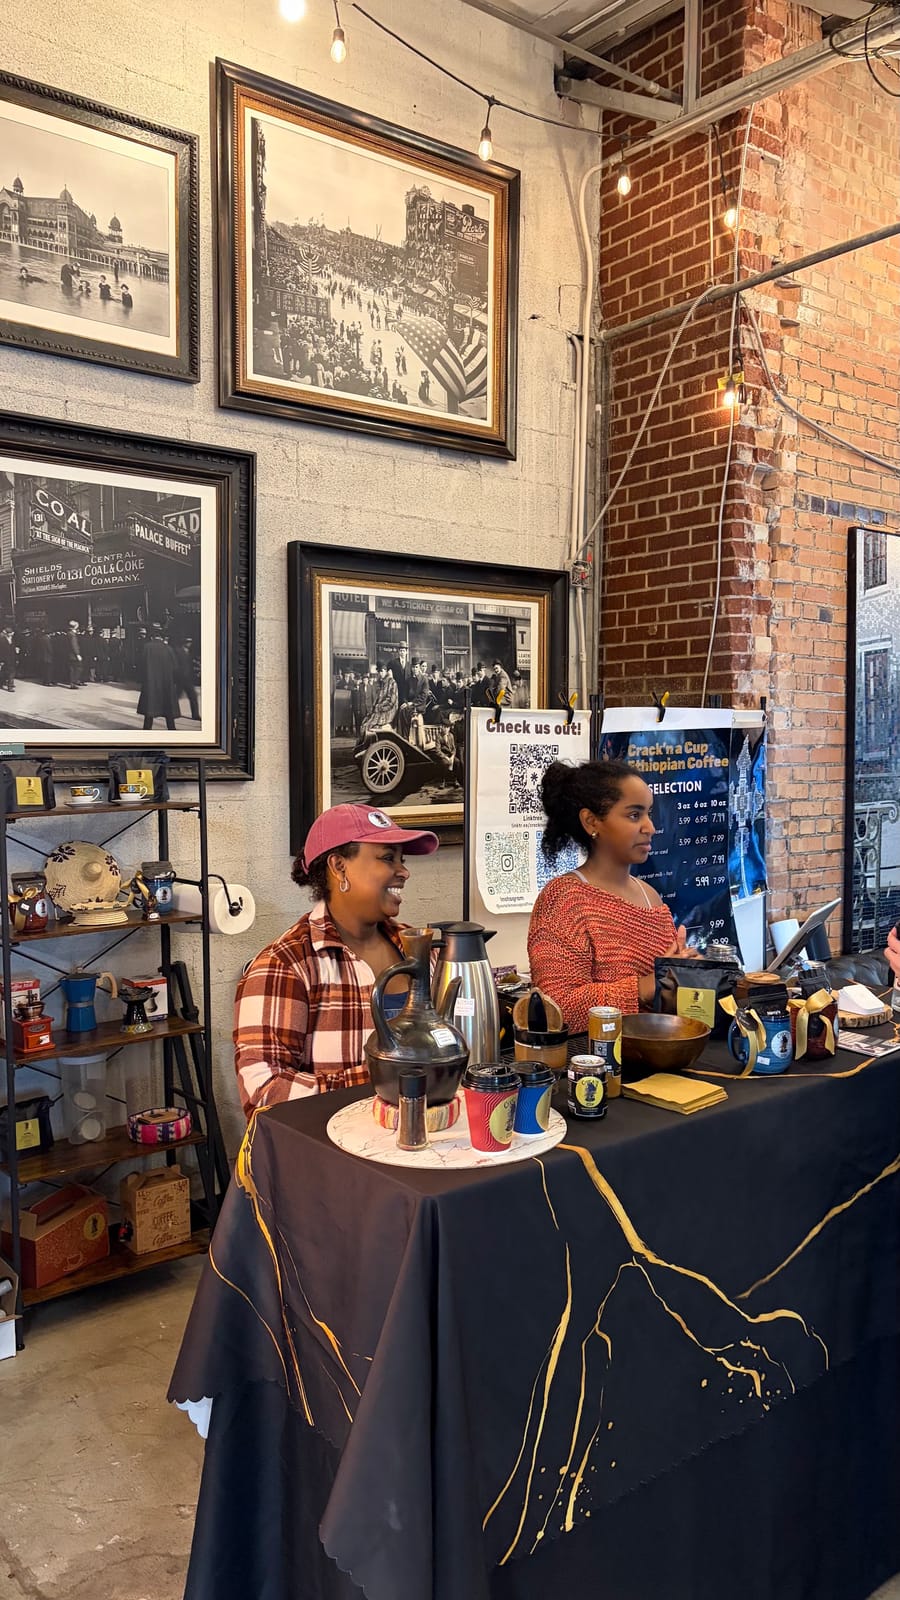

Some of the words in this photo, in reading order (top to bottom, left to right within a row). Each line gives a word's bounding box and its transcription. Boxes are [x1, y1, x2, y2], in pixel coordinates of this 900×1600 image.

[34, 513, 43, 522] 131
[36, 490, 91, 536] COAL
[135, 523, 164, 546] PALACE
[165, 536, 189, 555] BUFFET
[90, 551, 137, 564] CENTRAL
[24, 563, 63, 576] SHIELDS
[21, 573, 55, 585] STATIONERY
[67, 569, 84, 581] 131
[334, 592, 367, 603] HOTEL
[402, 601, 435, 612] STICKNEY
[518, 631, 526, 645] T
[486, 718, 531, 734] Check
[535, 723, 551, 735] us
[554, 722, 581, 736] out!
[675, 744, 682, 754] a
[684, 741, 708, 756] Cup
[687, 755, 729, 769] Coffee
[648, 780, 702, 795] SELECTION
[712, 834, 725, 843] 7.99
[695, 857, 708, 866] 6.99
[712, 854, 725, 864] 7.99
[695, 876, 710, 887] 5.99
[713, 876, 725, 885] 7.99
